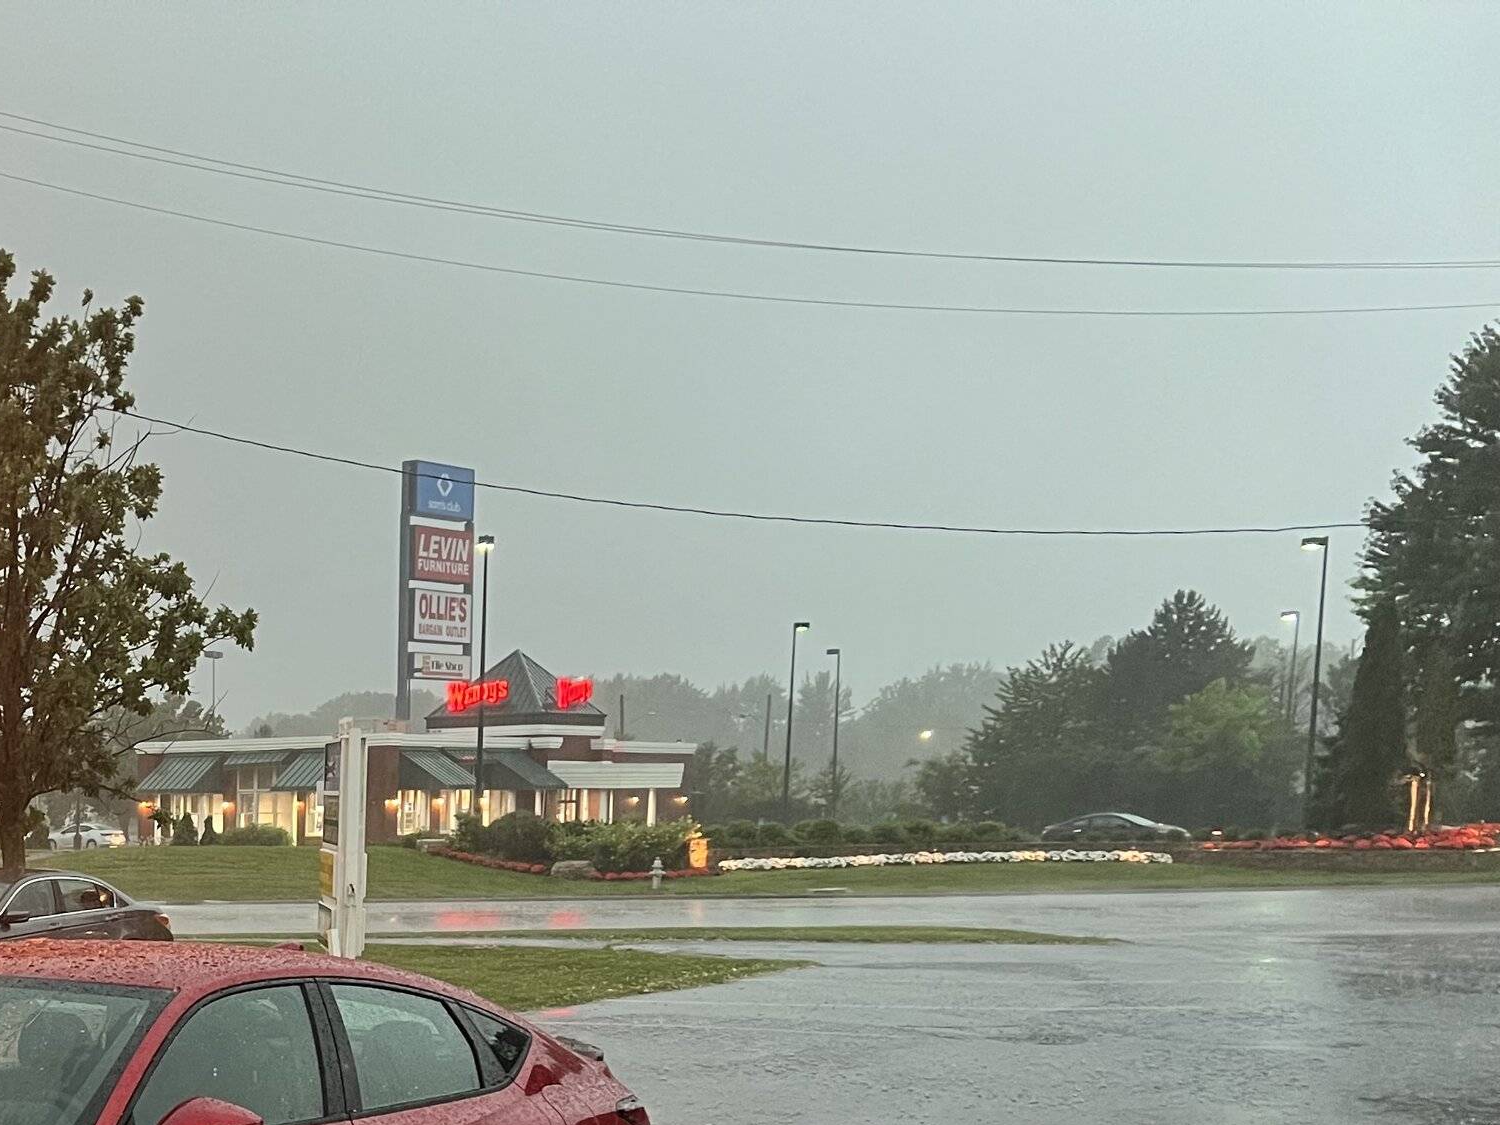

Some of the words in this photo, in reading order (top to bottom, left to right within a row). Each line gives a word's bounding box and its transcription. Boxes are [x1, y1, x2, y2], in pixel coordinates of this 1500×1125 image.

[419, 533, 470, 562] LEVIN
[418, 558, 469, 576] FURNITURE
[419, 593, 467, 623] OLLIE'S
